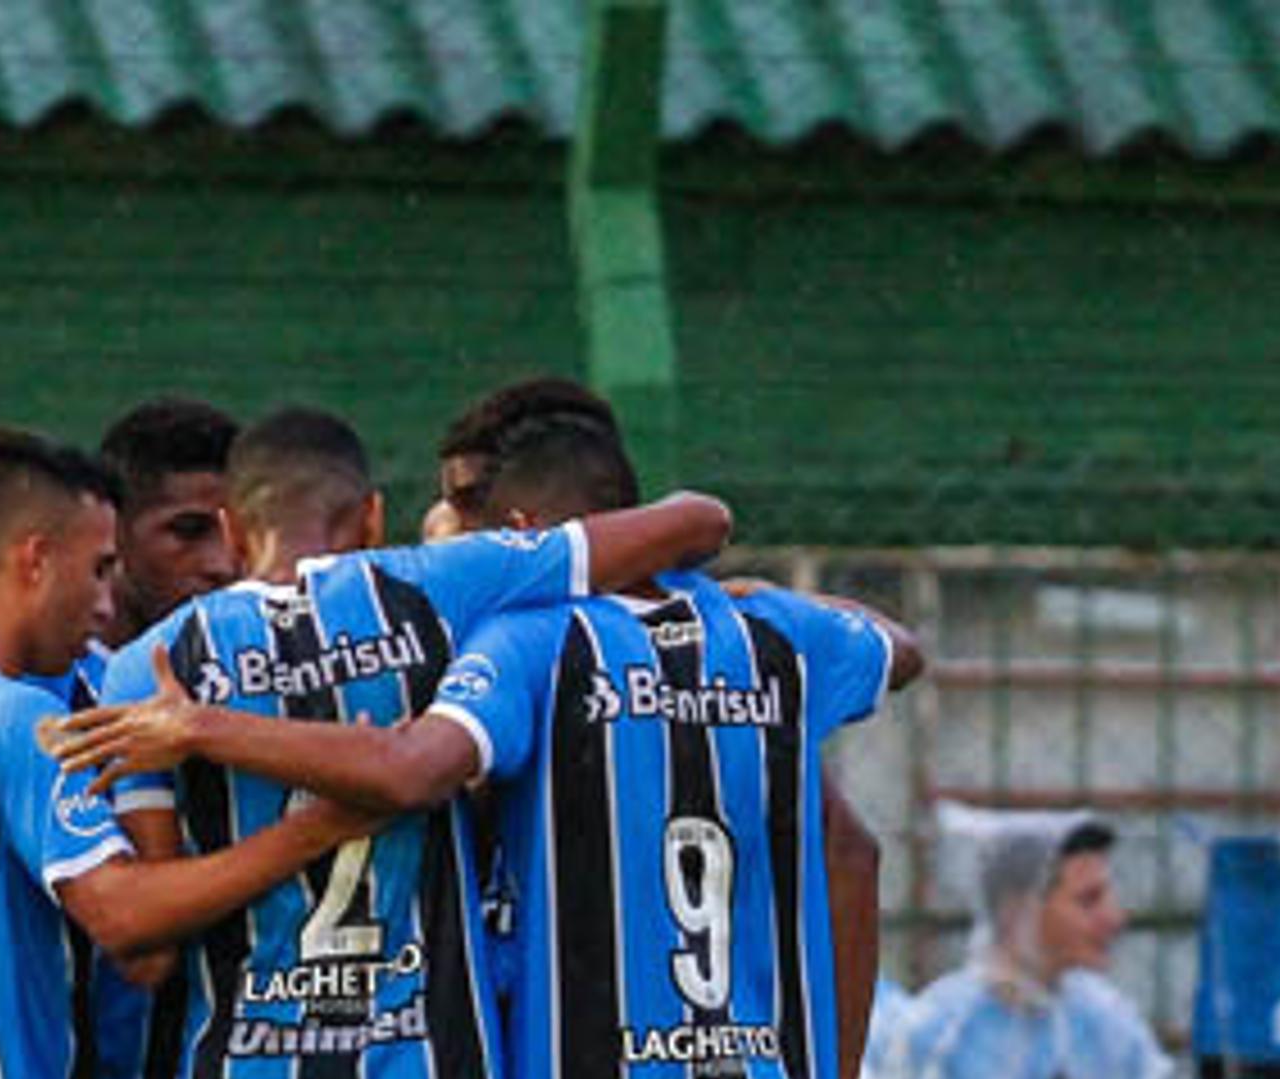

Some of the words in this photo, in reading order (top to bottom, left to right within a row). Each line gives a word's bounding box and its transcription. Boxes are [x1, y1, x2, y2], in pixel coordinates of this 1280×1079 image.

[238, 621, 426, 695] Banrisul
[627, 666, 782, 725] Banrisul
[288, 789, 382, 960] 2
[664, 816, 732, 1010] 9
